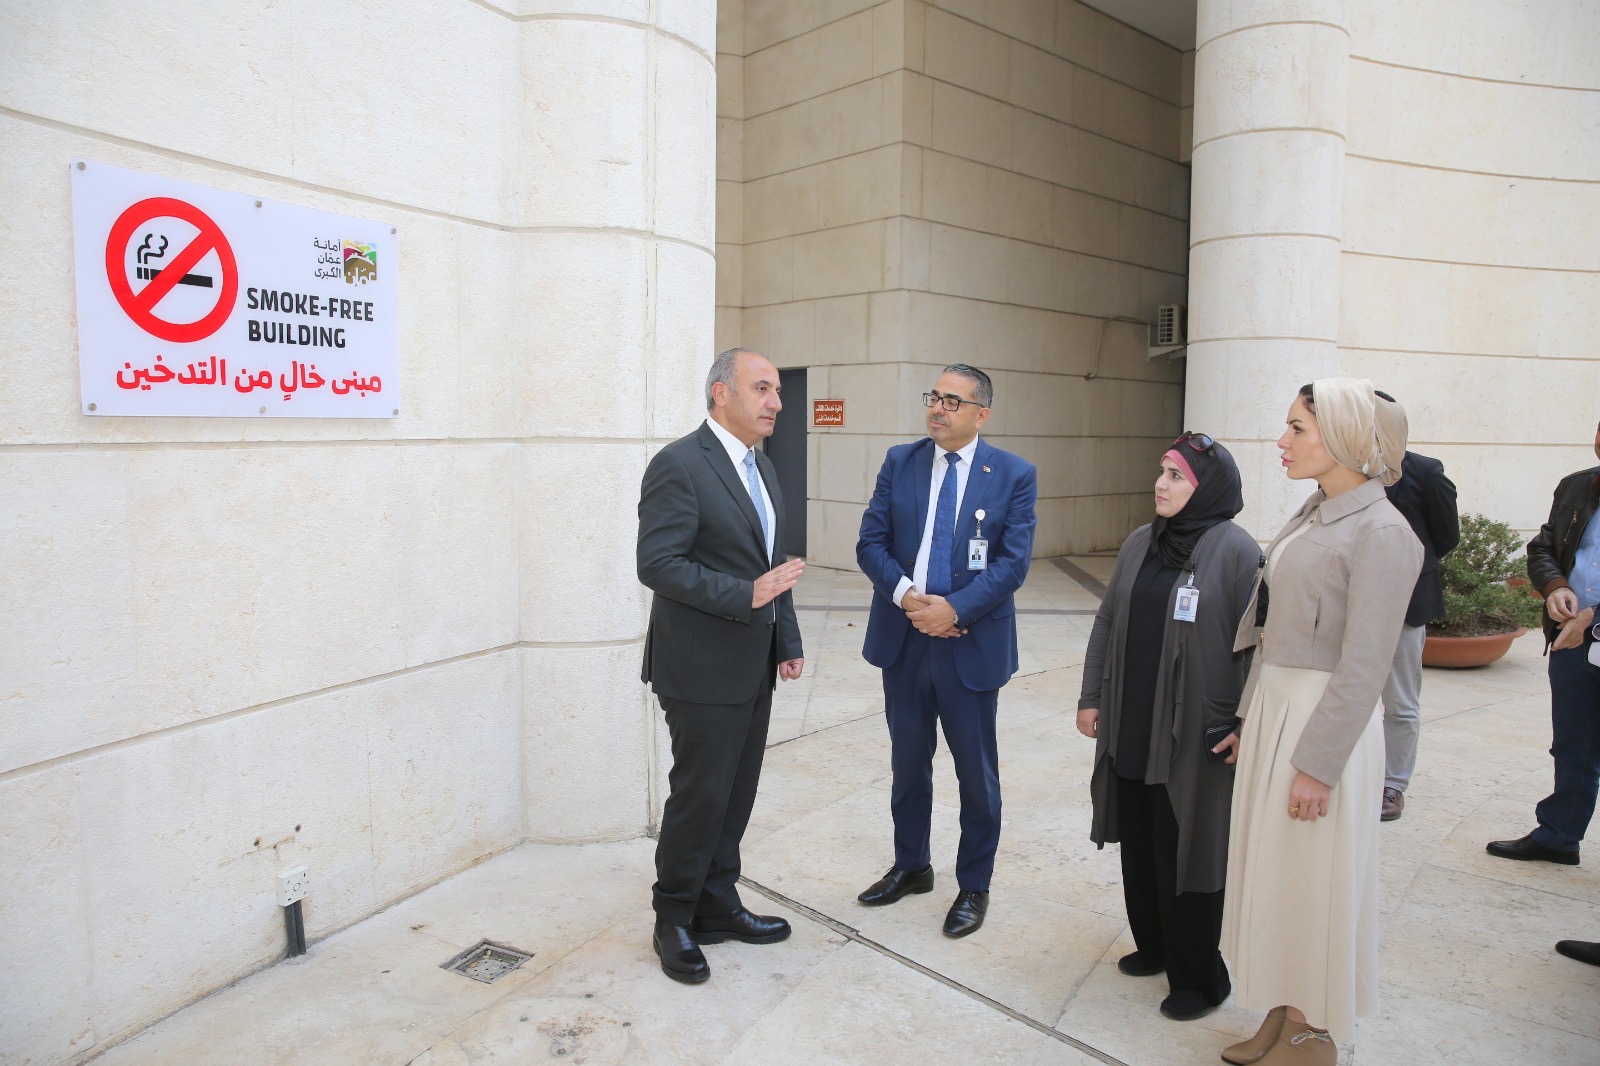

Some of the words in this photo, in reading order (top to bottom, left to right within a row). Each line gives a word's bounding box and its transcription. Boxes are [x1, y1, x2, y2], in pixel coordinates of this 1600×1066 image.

[313, 237, 341, 252] أمانة
[314, 266, 341, 279] الكبرى
[246, 287, 374, 322] SMOKE-FREE
[248, 319, 346, 348] BUILDING
[116, 355, 227, 390] التدخين
[235, 368, 273, 392] من
[332, 370, 382, 397] مبنى
